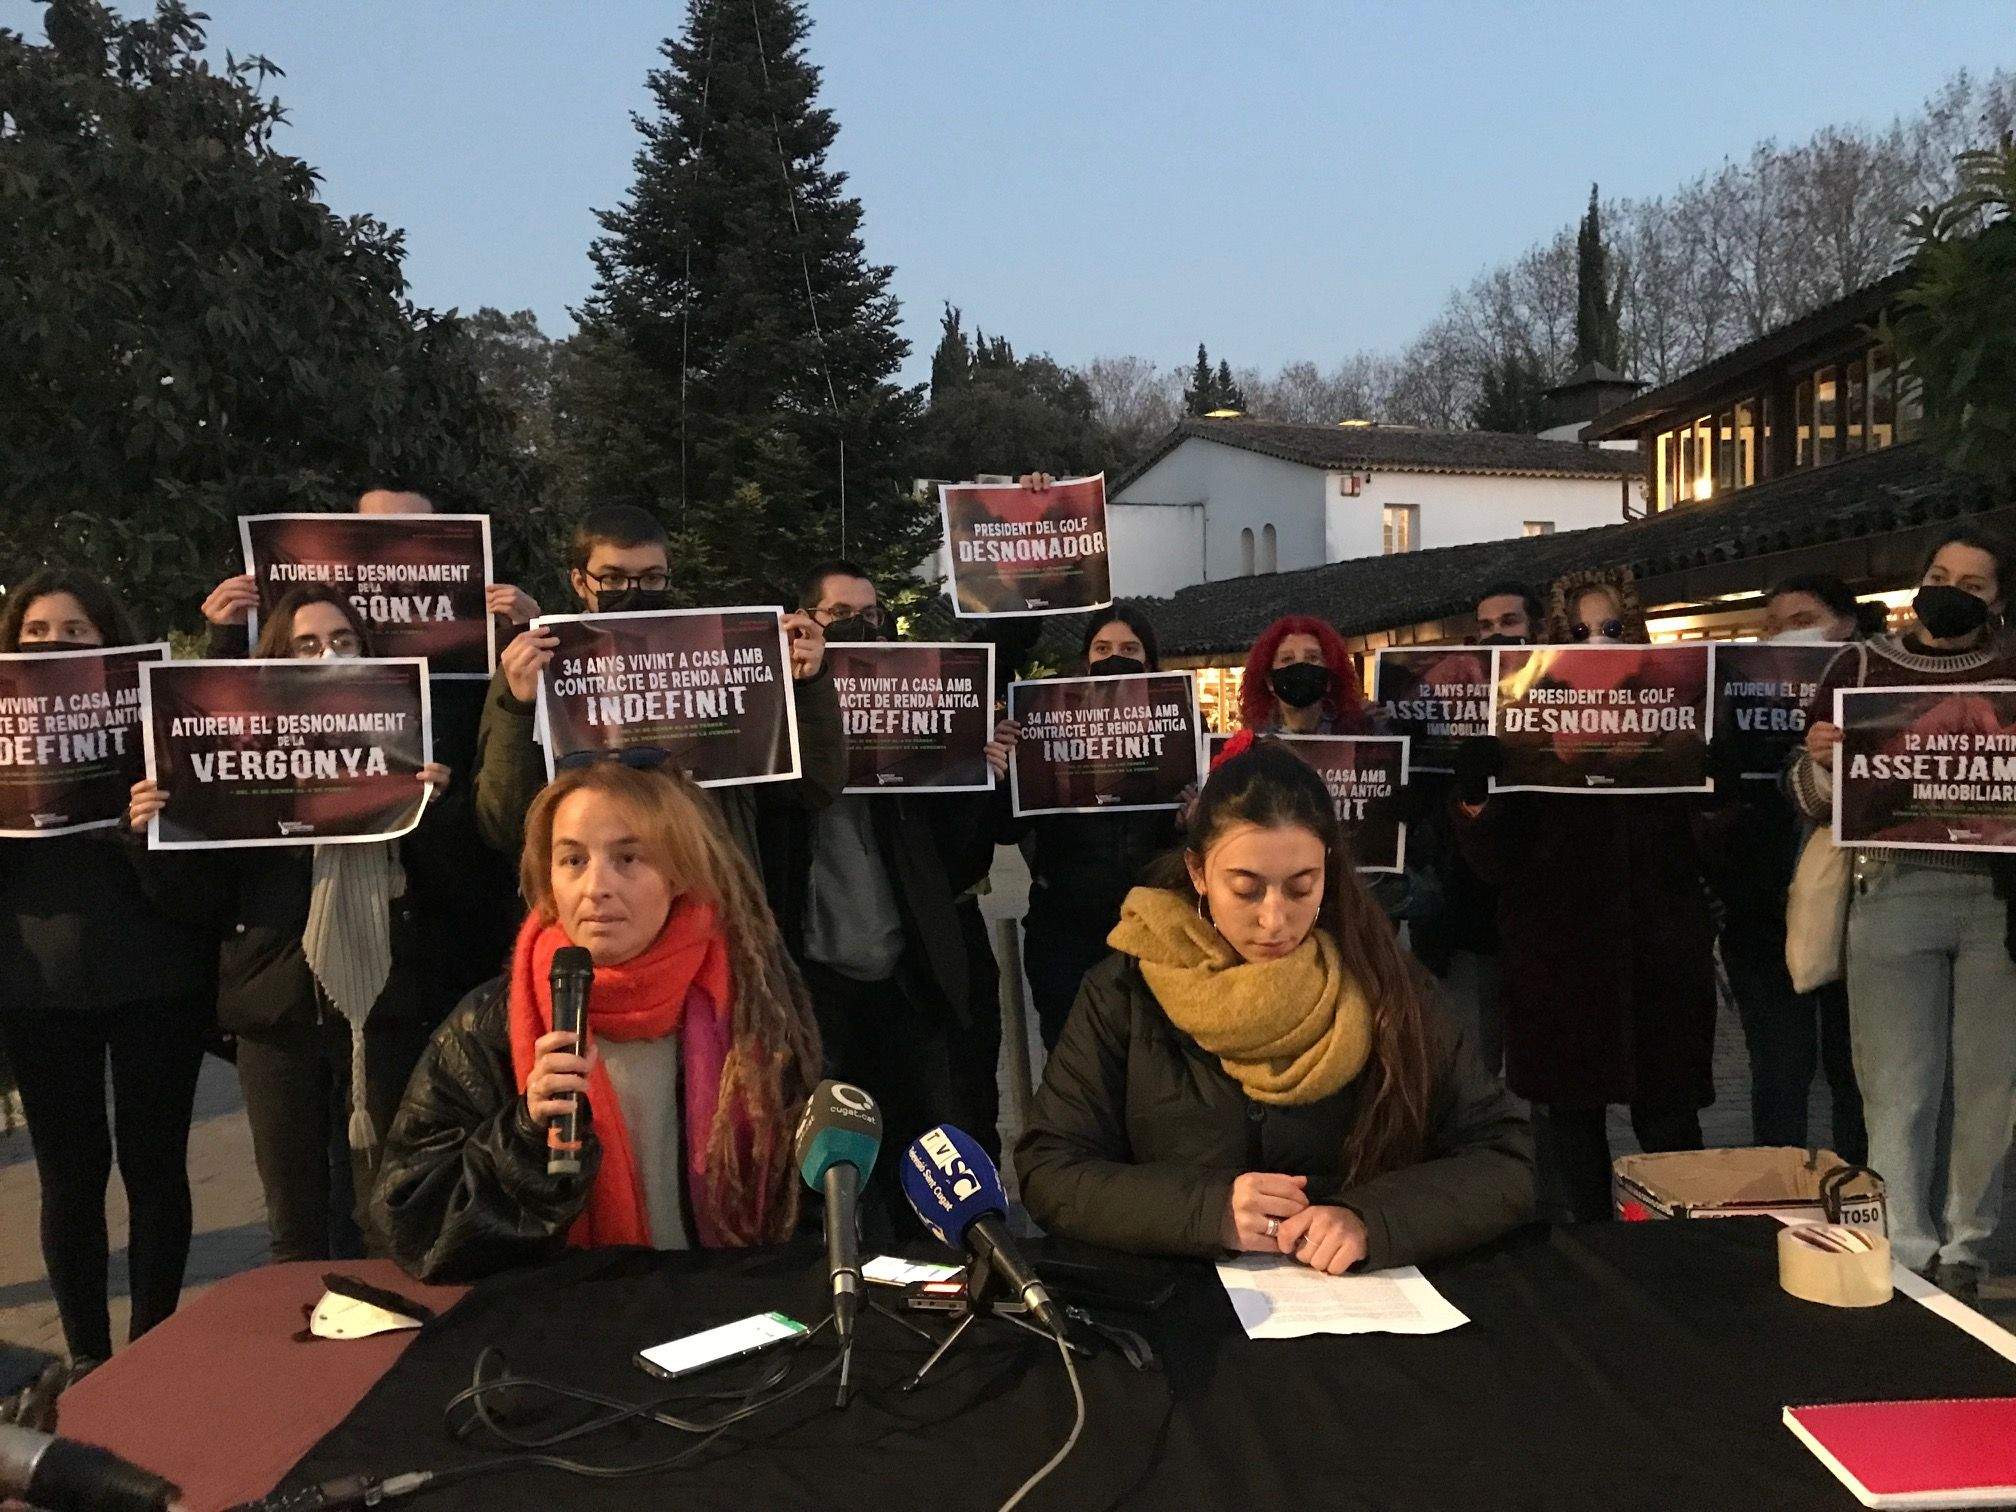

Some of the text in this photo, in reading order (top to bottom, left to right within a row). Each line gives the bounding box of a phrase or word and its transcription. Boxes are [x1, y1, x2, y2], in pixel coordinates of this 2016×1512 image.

[974, 517, 1088, 537] PRESIDENT DEL GOLF
[958, 531, 1105, 563] DESNONADOR
[269, 564, 470, 582] ATUREM EL DESNONAMENT
[358, 583, 382, 594] DE LA
[562, 647, 764, 676] 34 ANYS VIVINT A CASA AMB
[554, 665, 774, 697] CONTRACTE DE RENDA ANTIGA
[860, 677, 898, 692] VIVINT
[901, 678, 909, 691] A
[912, 678, 943, 692] CASA
[946, 678, 972, 692] AMB
[1433, 683, 1464, 697] ANYS
[1723, 682, 1776, 697] ATUREM
[1780, 682, 1796, 697] EL
[54, 695, 65, 713] A
[70, 691, 111, 712] CASA
[115, 688, 141, 706] AM
[586, 686, 747, 726] INDEFINIT
[875, 693, 890, 708] DE
[894, 693, 934, 708] RENDA
[937, 693, 979, 708] ANTIGA
[1529, 687, 1675, 704] PRESIDENT DEL GOLF
[18, 716, 39, 734] DE
[45, 712, 100, 733] RENDA
[171, 713, 406, 737] ATUREM EL DESNONAMENT
[1027, 703, 1179, 725] 34 ANYS VIVINT A CASA AMB
[1505, 706, 1696, 734] DESNONADOR
[1021, 717, 1187, 741] CONTRACTE DE RENDA ANTIGA
[277, 736, 305, 747] DE LA
[1043, 733, 1166, 762] INDEFINIT
[1904, 734, 1921, 751] 12
[1925, 734, 1970, 752] ANYS
[190, 746, 389, 783] VERGONYA
[1326, 769, 1387, 783] CASA AMB
[830, 1106, 877, 1125] cugat.cat
[922, 1169, 936, 1190] Sant
[933, 1186, 954, 1212] Cugat
